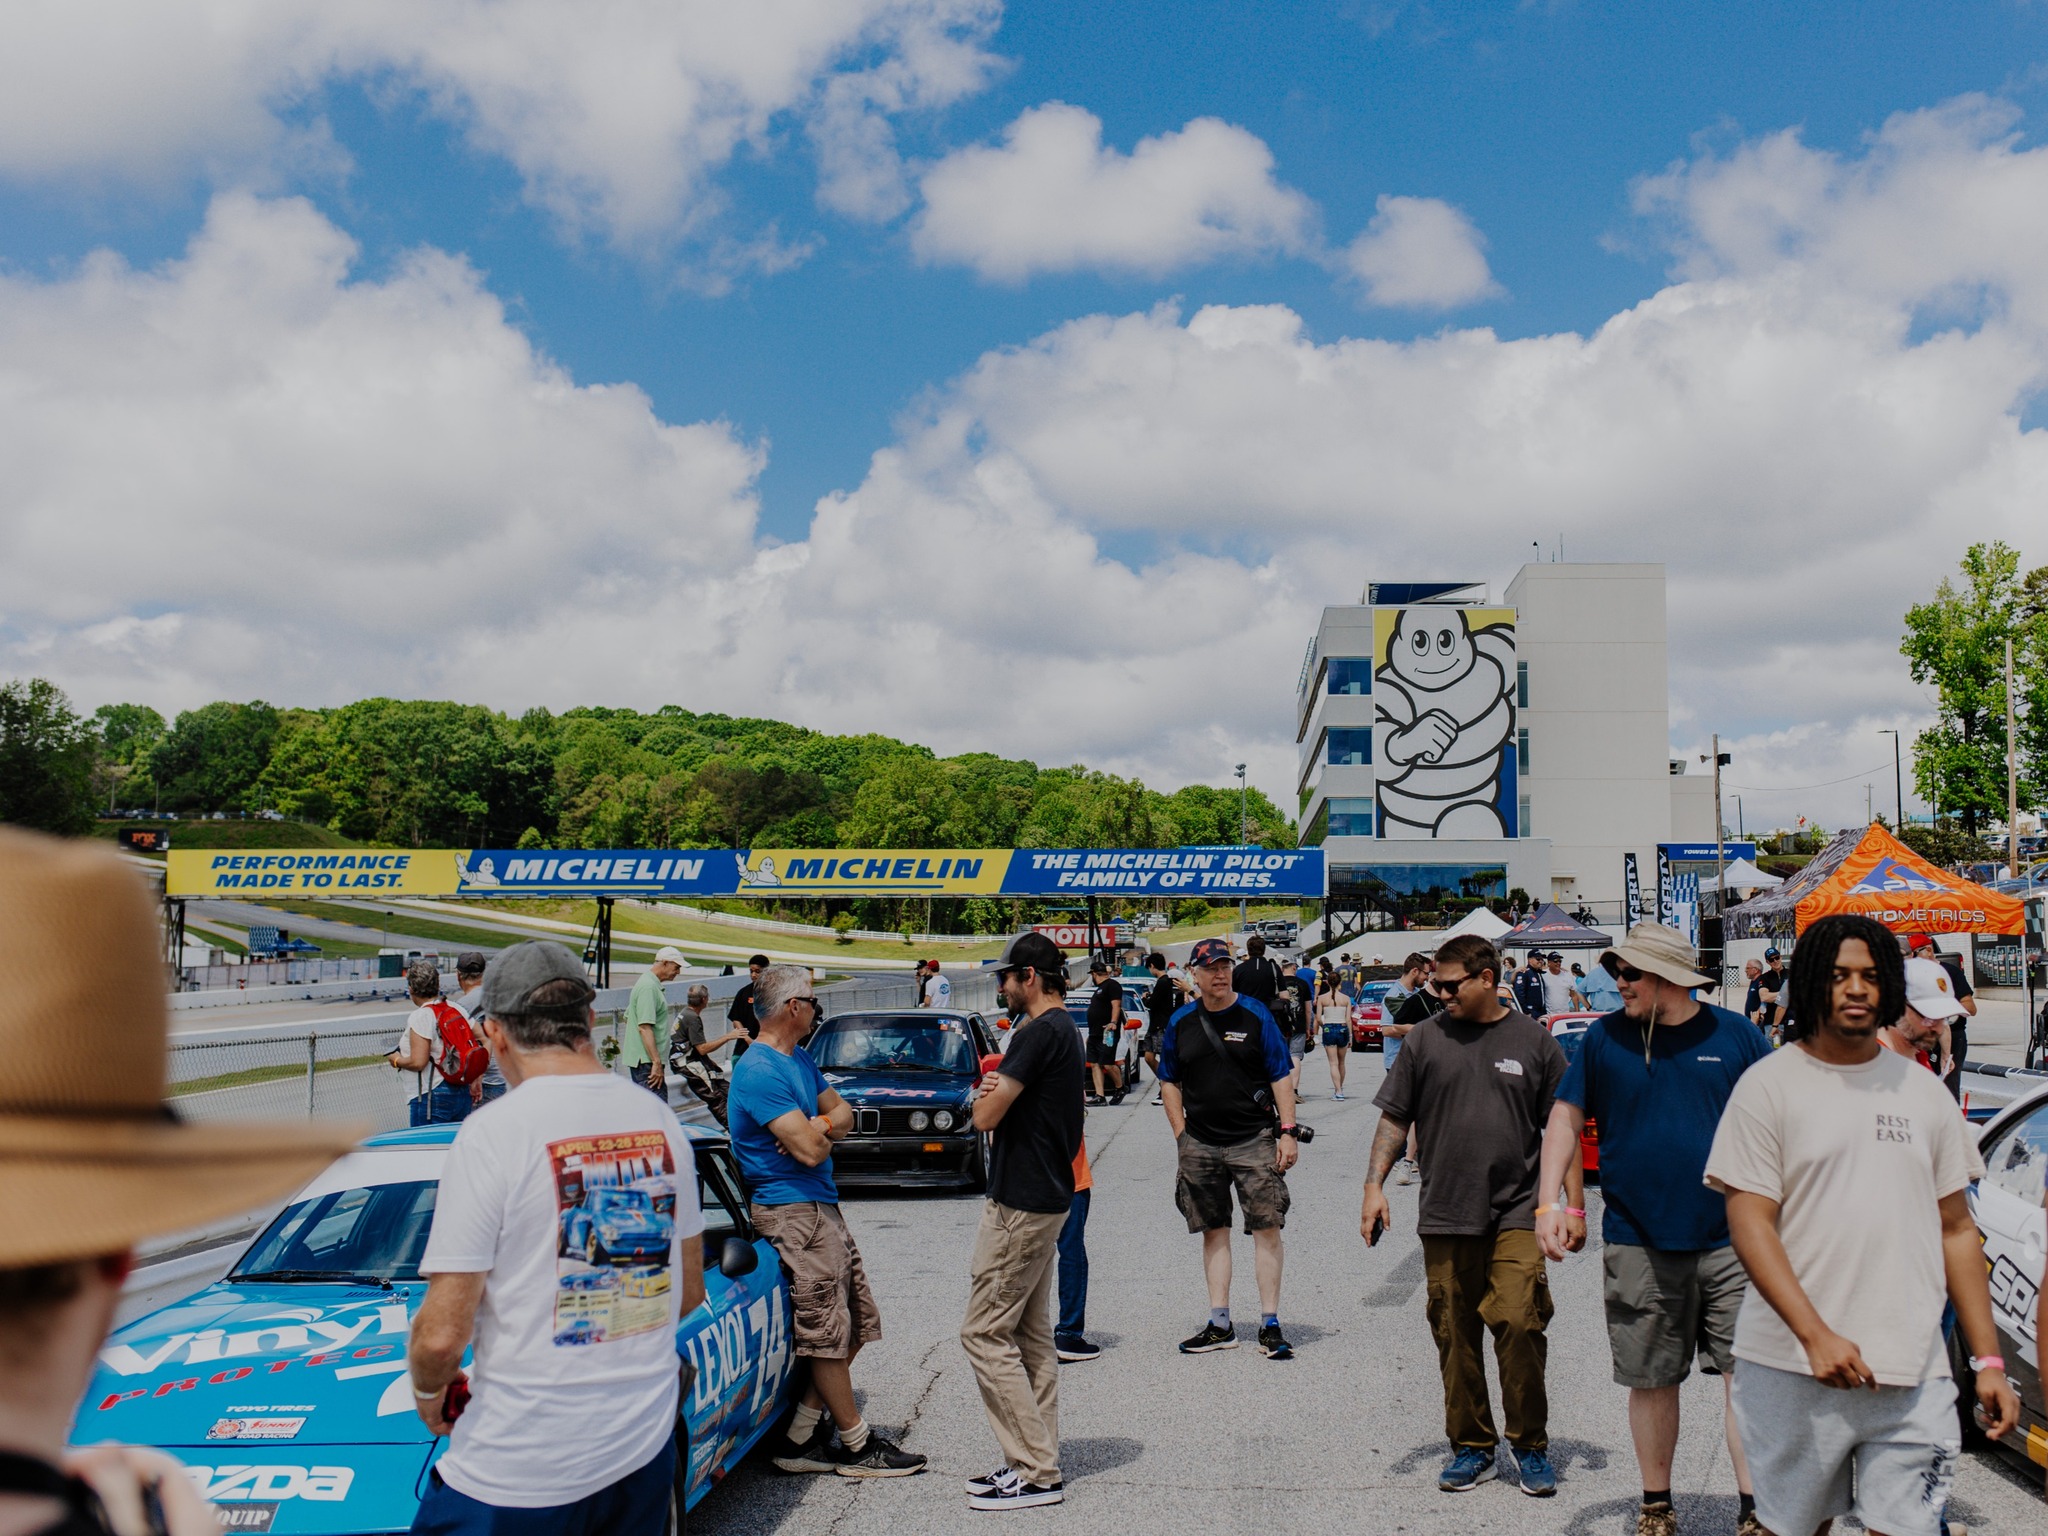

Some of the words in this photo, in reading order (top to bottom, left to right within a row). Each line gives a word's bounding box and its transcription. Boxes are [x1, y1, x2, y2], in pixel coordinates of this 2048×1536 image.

[132, 833, 156, 847] FOX
[211, 855, 411, 869] PERFORMANCE
[785, 858, 984, 879] MICHELIN
[1032, 854, 1085, 869] THE
[503, 859, 704, 881] MICHELIN
[215, 873, 294, 888] MADE
[302, 873, 332, 887] TO
[338, 873, 402, 887] LAST.
[1057, 872, 1156, 887] FAMILY
[1159, 872, 1195, 887] OF
[1200, 872, 1276, 888] TIRES.
[1846, 879, 1951, 894] APEX
[1660, 851, 1672, 928] AGERTY
[1877, 1115, 1909, 1129] REST
[1877, 1129, 1911, 1144] EASY
[556, 1140, 597, 1157] APRIL
[98, 1303, 411, 1376] Vinyl
[748, 1285, 787, 1415] 74
[686, 1303, 751, 1417] LEXOL
[97, 1344, 408, 1411] PROTEC
[226, 1405, 269, 1413] TOYO
